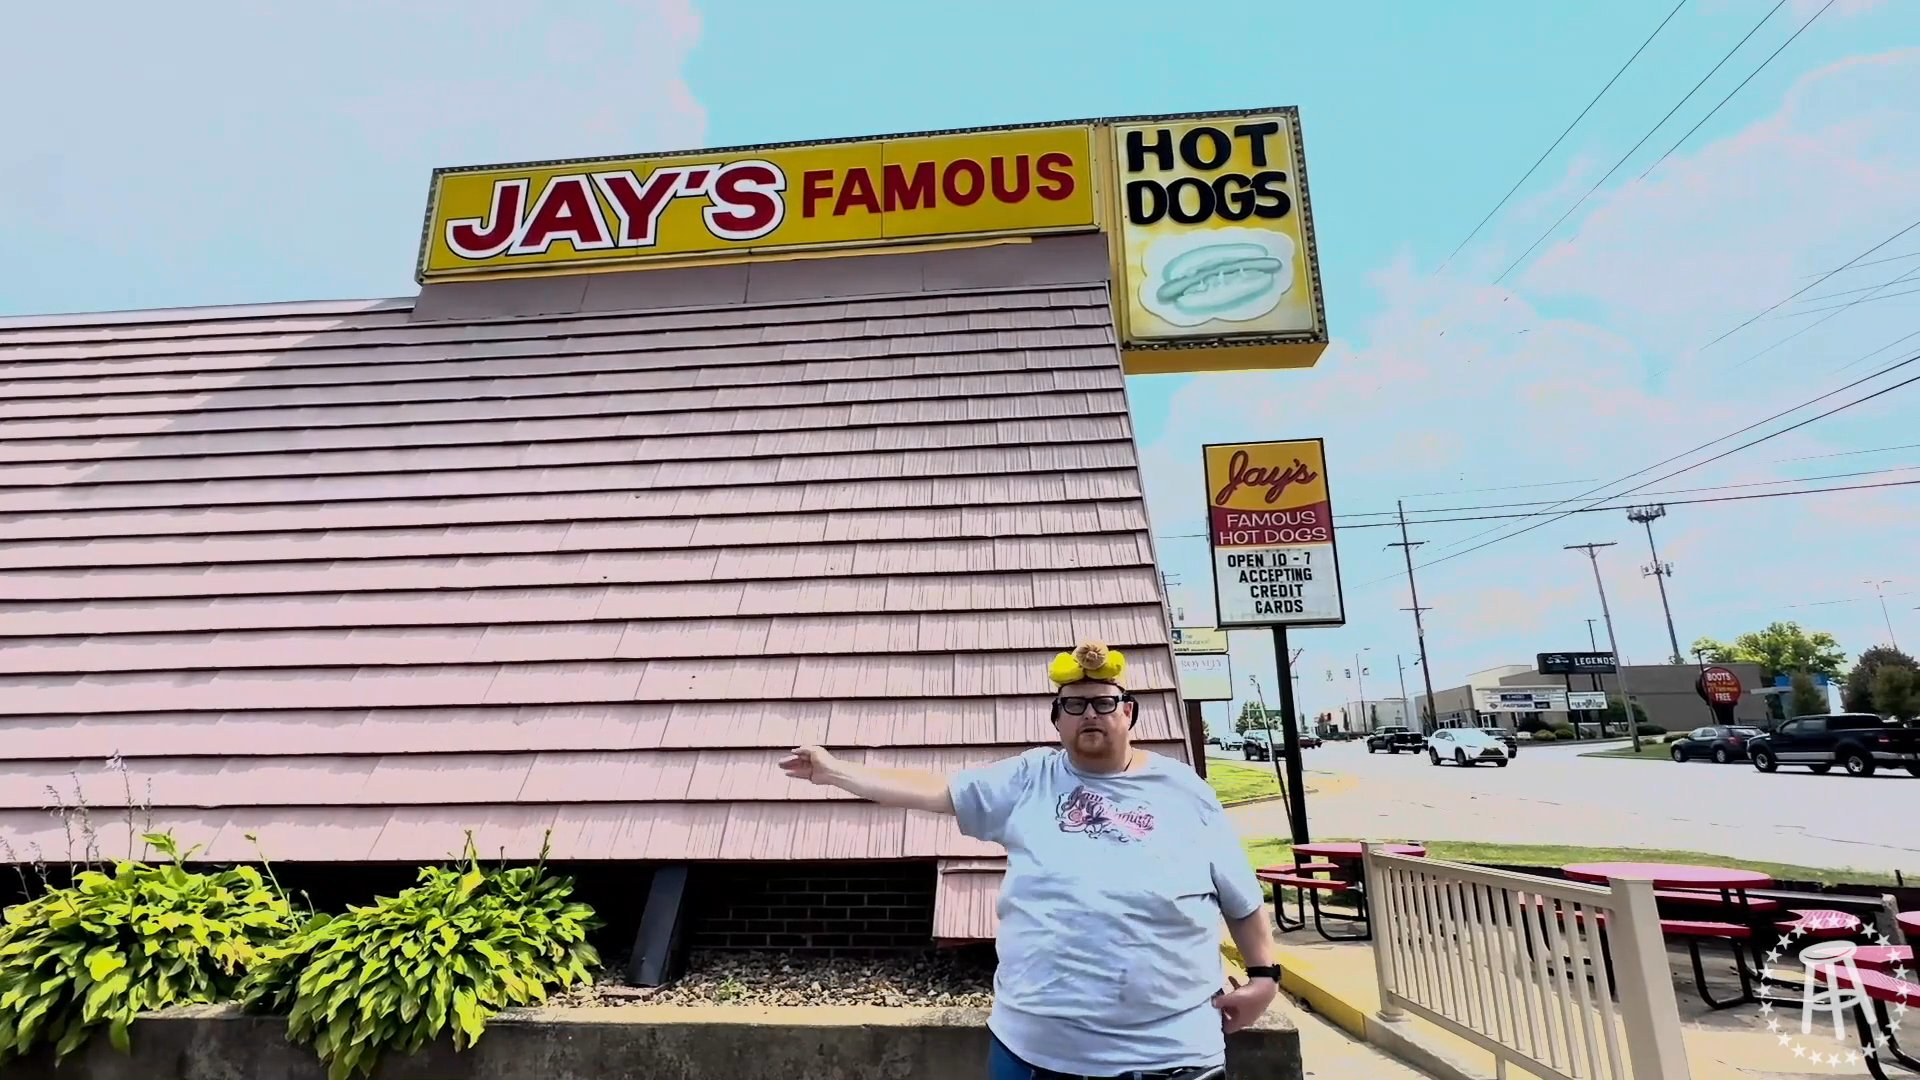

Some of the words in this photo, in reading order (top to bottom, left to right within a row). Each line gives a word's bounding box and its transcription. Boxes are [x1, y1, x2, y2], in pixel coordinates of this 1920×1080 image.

[1126, 121, 1280, 172] HOT
[446, 160, 787, 260] JAY'S
[801, 152, 1076, 219] FAMOUS
[1126, 171, 1292, 225] DOGS
[1215, 450, 1319, 505] Jay's
[1226, 510, 1317, 528] FAMOUS
[1219, 530, 1260, 545] HOT
[1264, 527, 1328, 543] DOGS
[1227, 553, 1264, 568] OPEN
[1272, 552, 1287, 567] 10
[1304, 551, 1312, 565] 7
[1239, 567, 1313, 583] ACCEPTING
[1250, 583, 1304, 598] CREDIT
[1255, 599, 1304, 614] CARDS
[1574, 656, 1616, 666] LEGENDS
[1706, 672, 1731, 682] BOOTS
[1715, 692, 1732, 702] FREE
